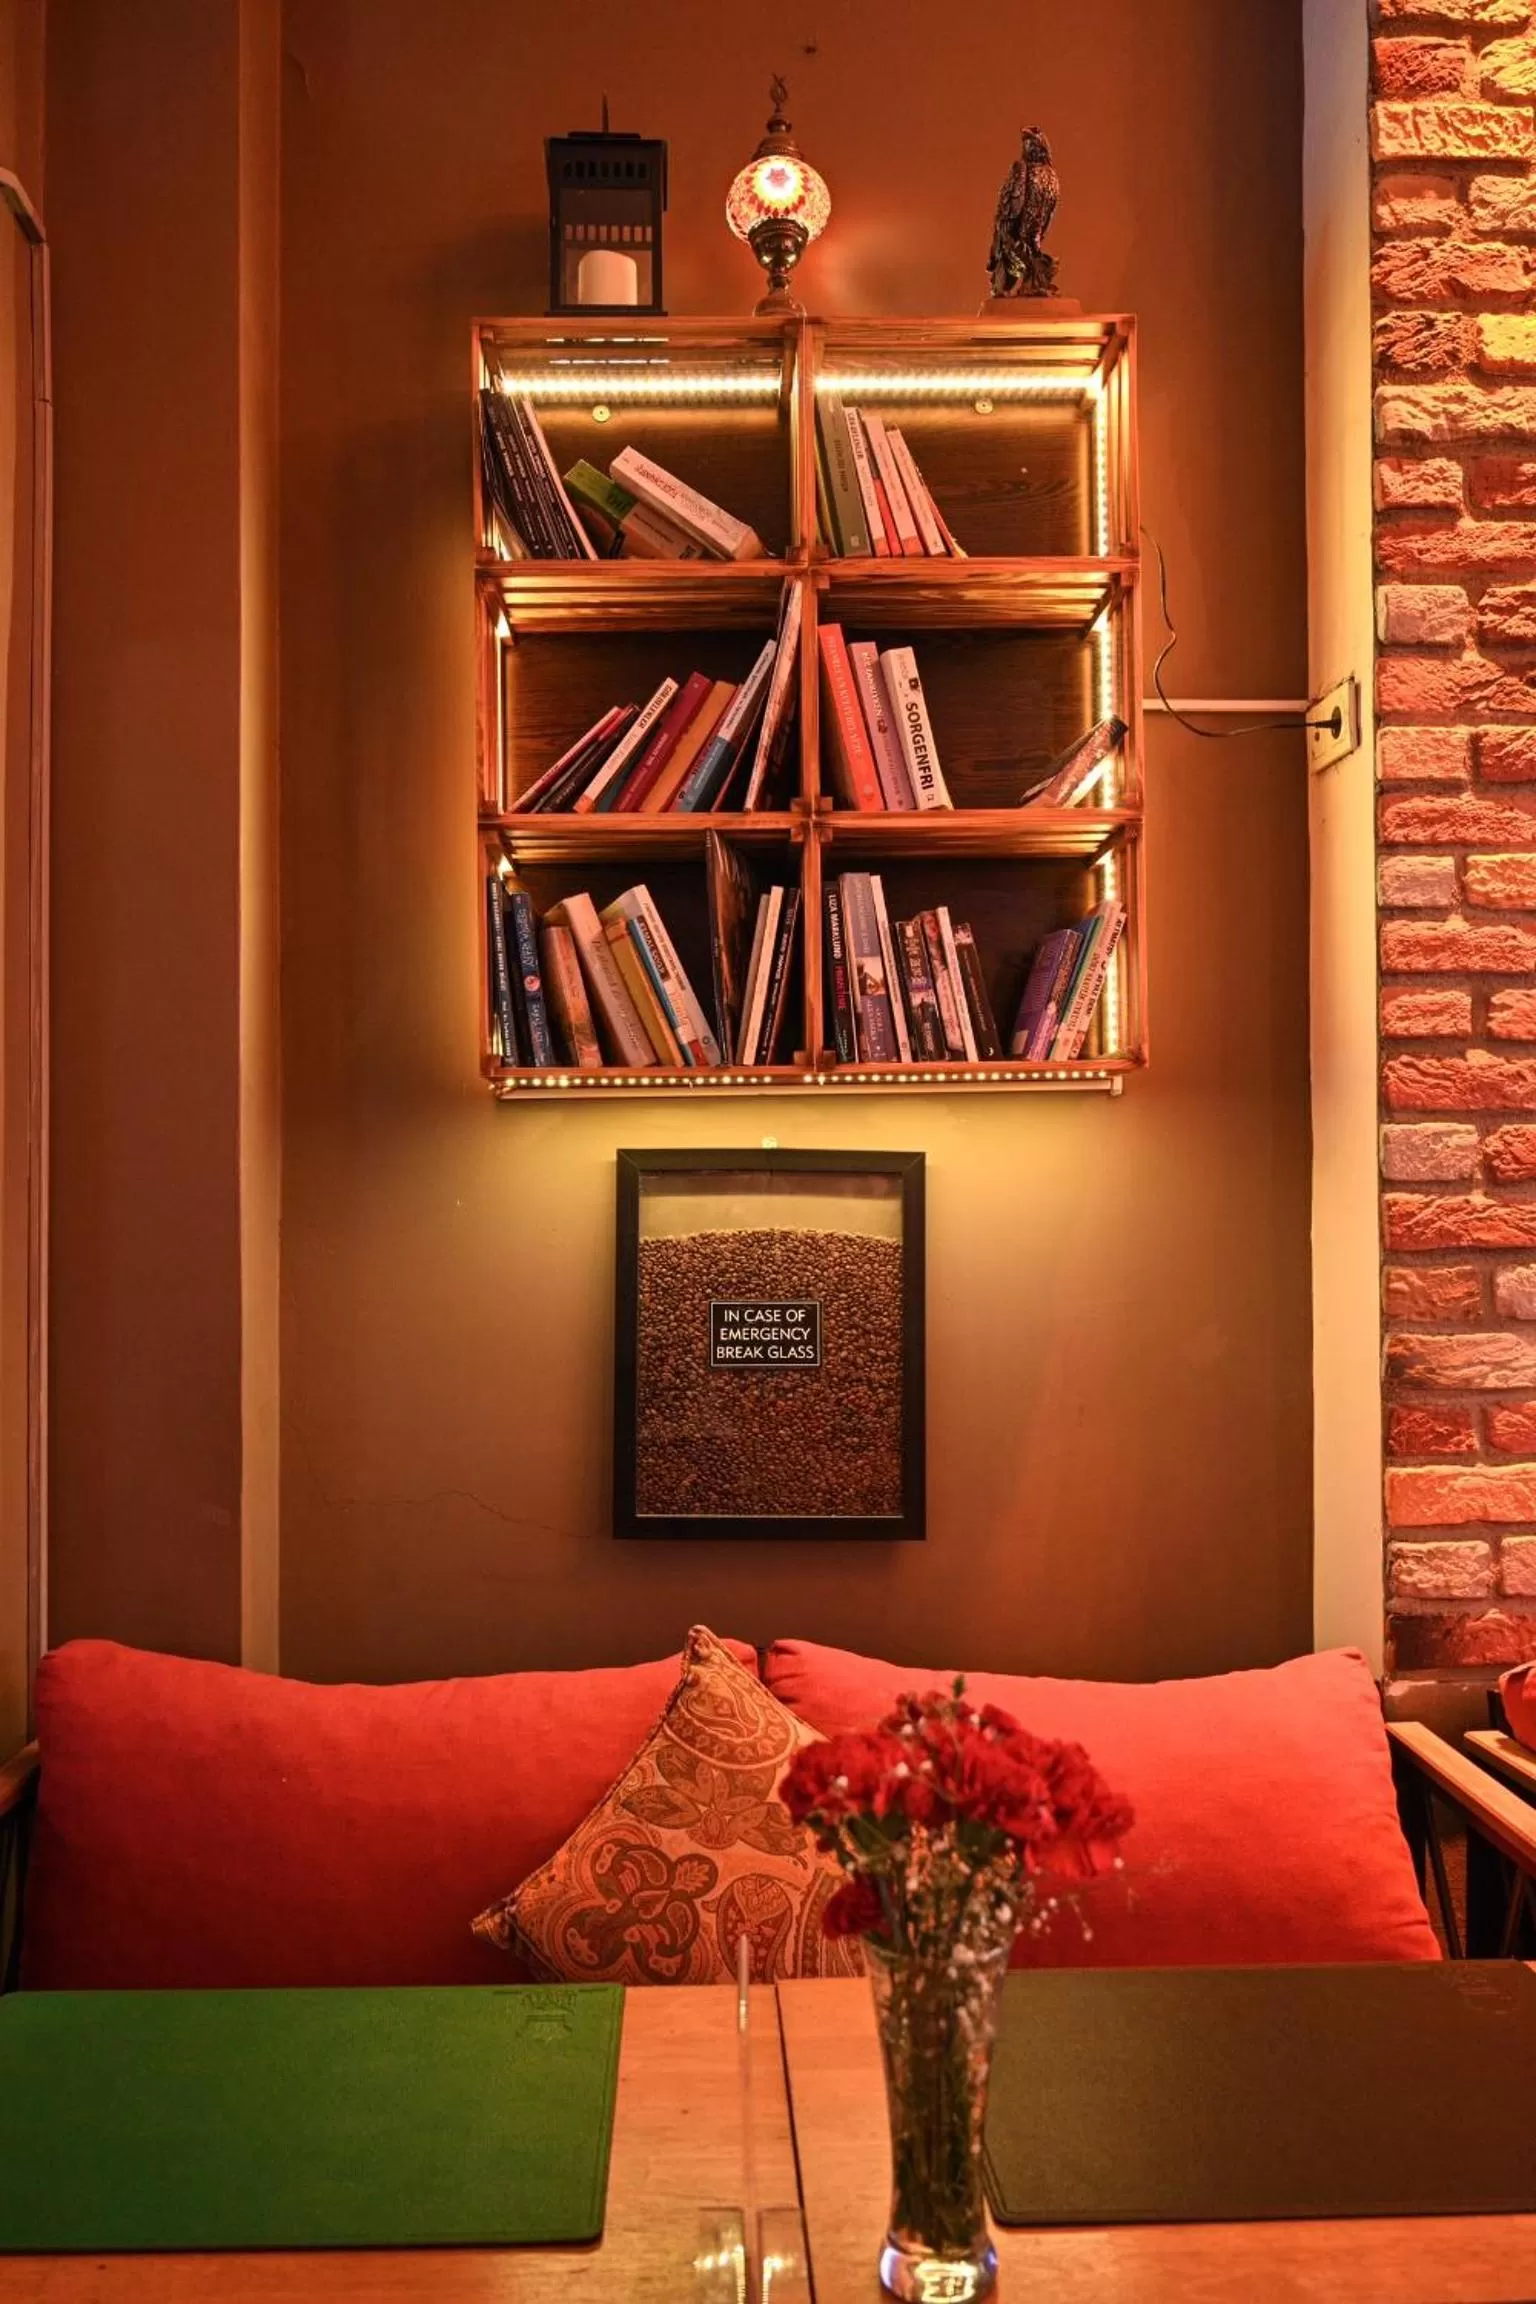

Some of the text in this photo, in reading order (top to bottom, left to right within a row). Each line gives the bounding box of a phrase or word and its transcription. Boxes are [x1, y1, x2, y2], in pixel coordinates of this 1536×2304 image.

[905, 702, 934, 790] SORGENFRI
[827, 894, 837, 912] LIZA
[830, 912, 842, 959] MARKLUND
[724, 1309, 807, 1323] IN CASE OF
[719, 1327, 811, 1341] EMERGENCY
[716, 1345, 815, 1360] BREAK GLASS
